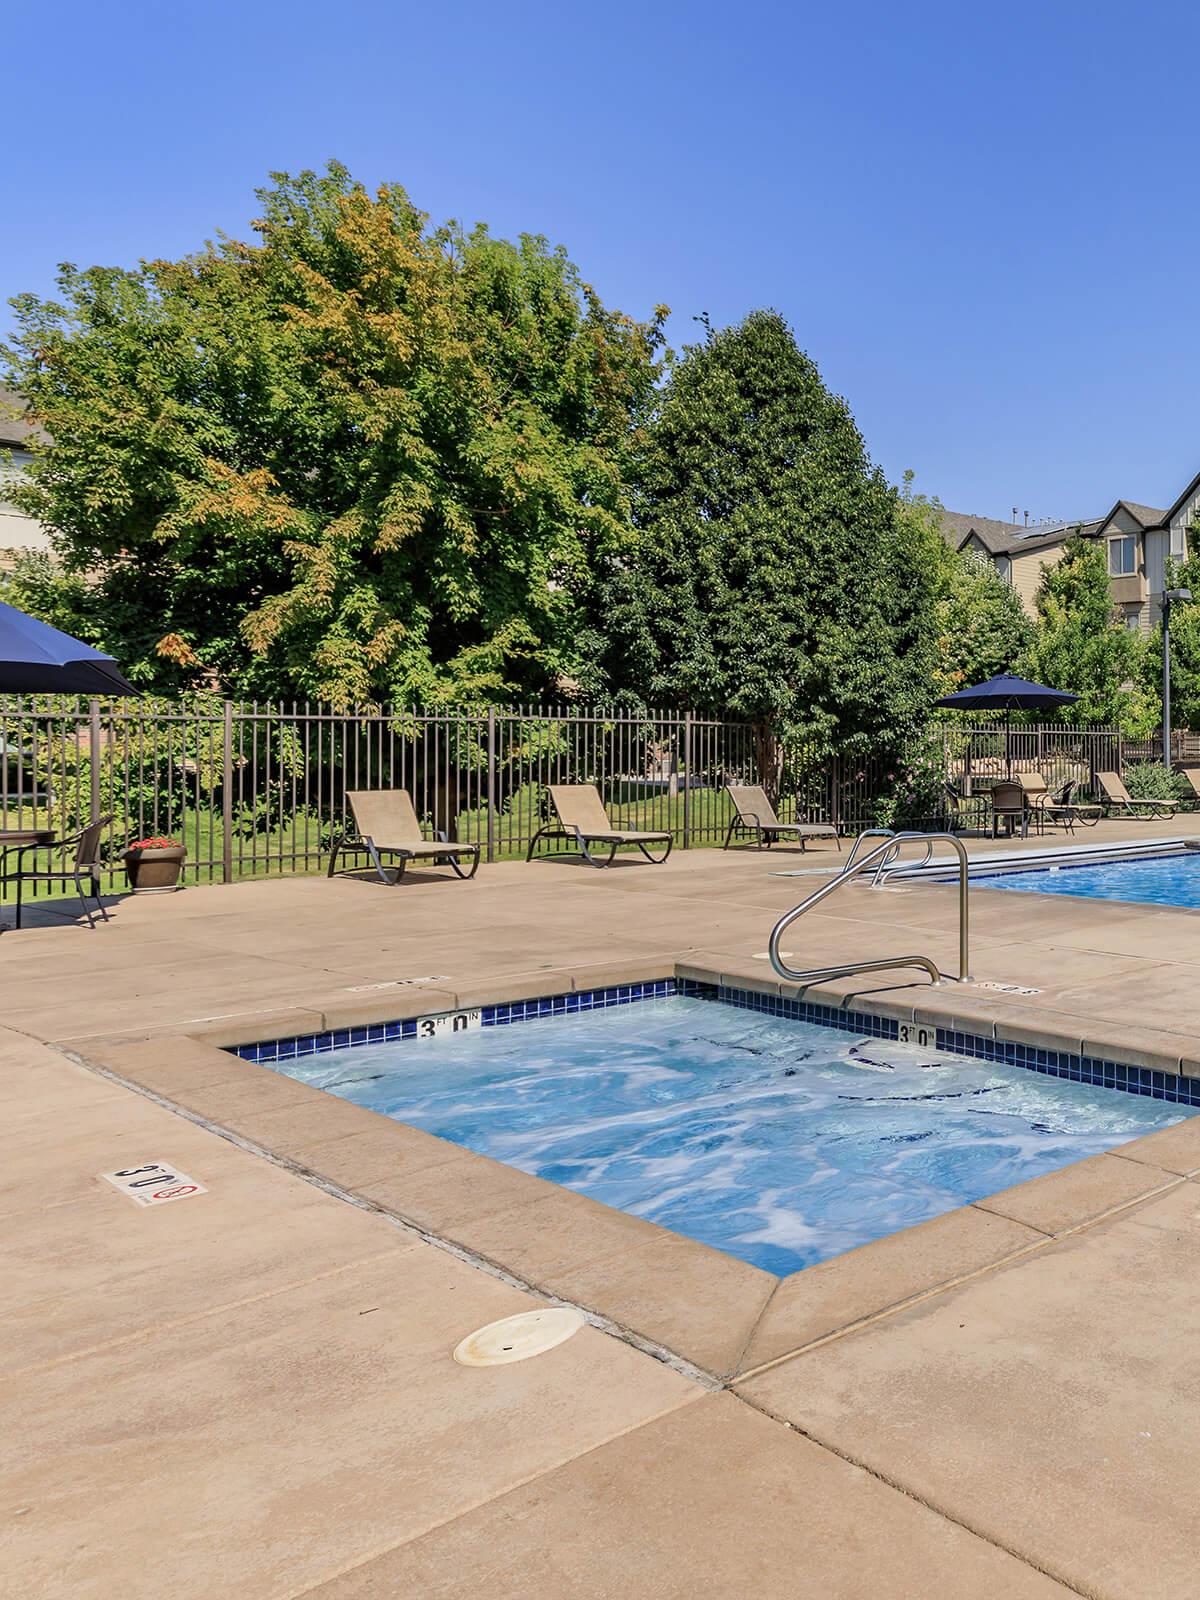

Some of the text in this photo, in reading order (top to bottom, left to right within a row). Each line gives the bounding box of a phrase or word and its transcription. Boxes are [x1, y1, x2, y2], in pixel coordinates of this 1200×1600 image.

[420, 1020, 436, 1038] 3
[469, 1012, 479, 1021] IN
[900, 1025, 909, 1043] 3
[114, 1165, 160, 1177] 3
[127, 1174, 175, 1188] 0
